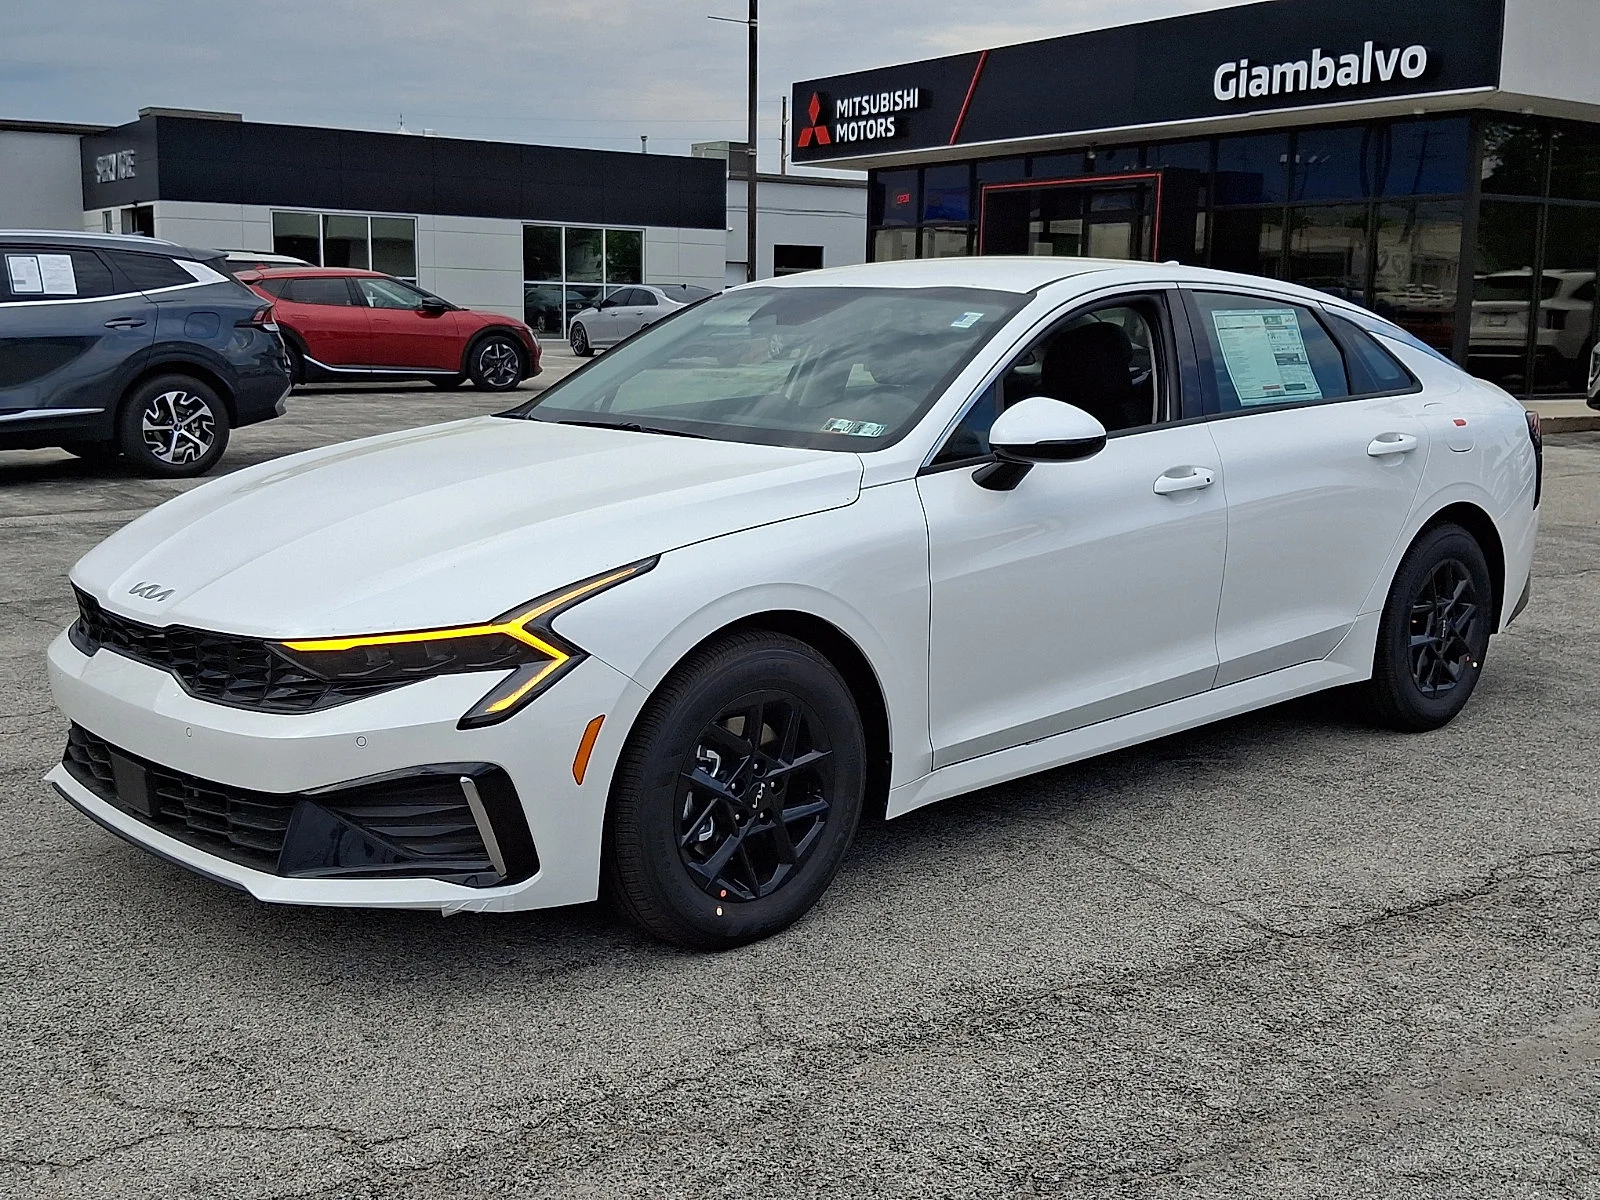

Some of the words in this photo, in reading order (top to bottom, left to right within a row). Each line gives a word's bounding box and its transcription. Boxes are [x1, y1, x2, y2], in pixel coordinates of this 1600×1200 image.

[1213, 40, 1427, 101] Giambalvo
[836, 88, 919, 119] MITSUBISHI
[836, 116, 896, 143] MOTORS
